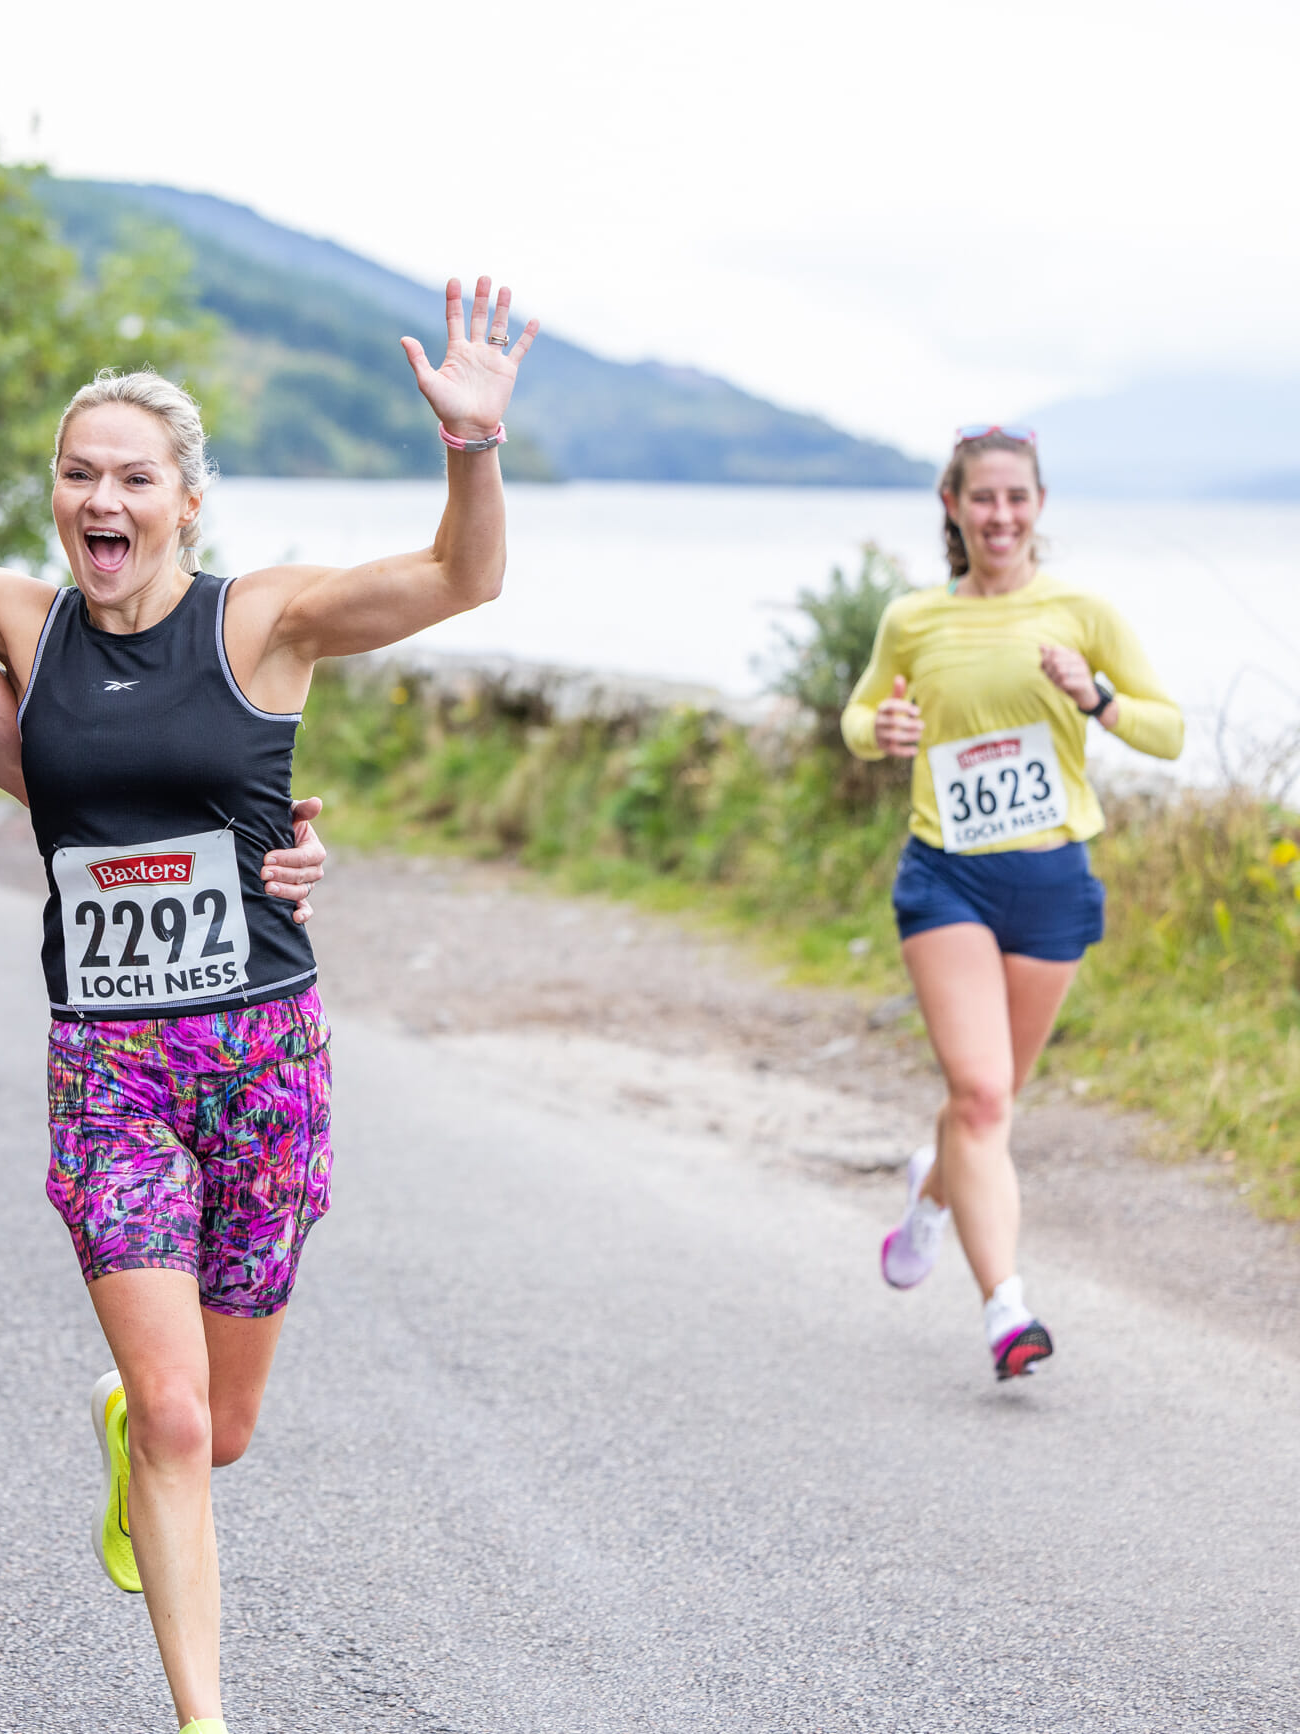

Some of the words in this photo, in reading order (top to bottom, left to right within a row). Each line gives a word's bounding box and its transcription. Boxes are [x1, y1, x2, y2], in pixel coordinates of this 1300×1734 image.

[949, 760, 1051, 822] 3623
[96, 861, 187, 885] Baxters
[75, 888, 235, 968] 2292
[81, 974, 155, 998] LOCH
[164, 961, 237, 994] NESS
